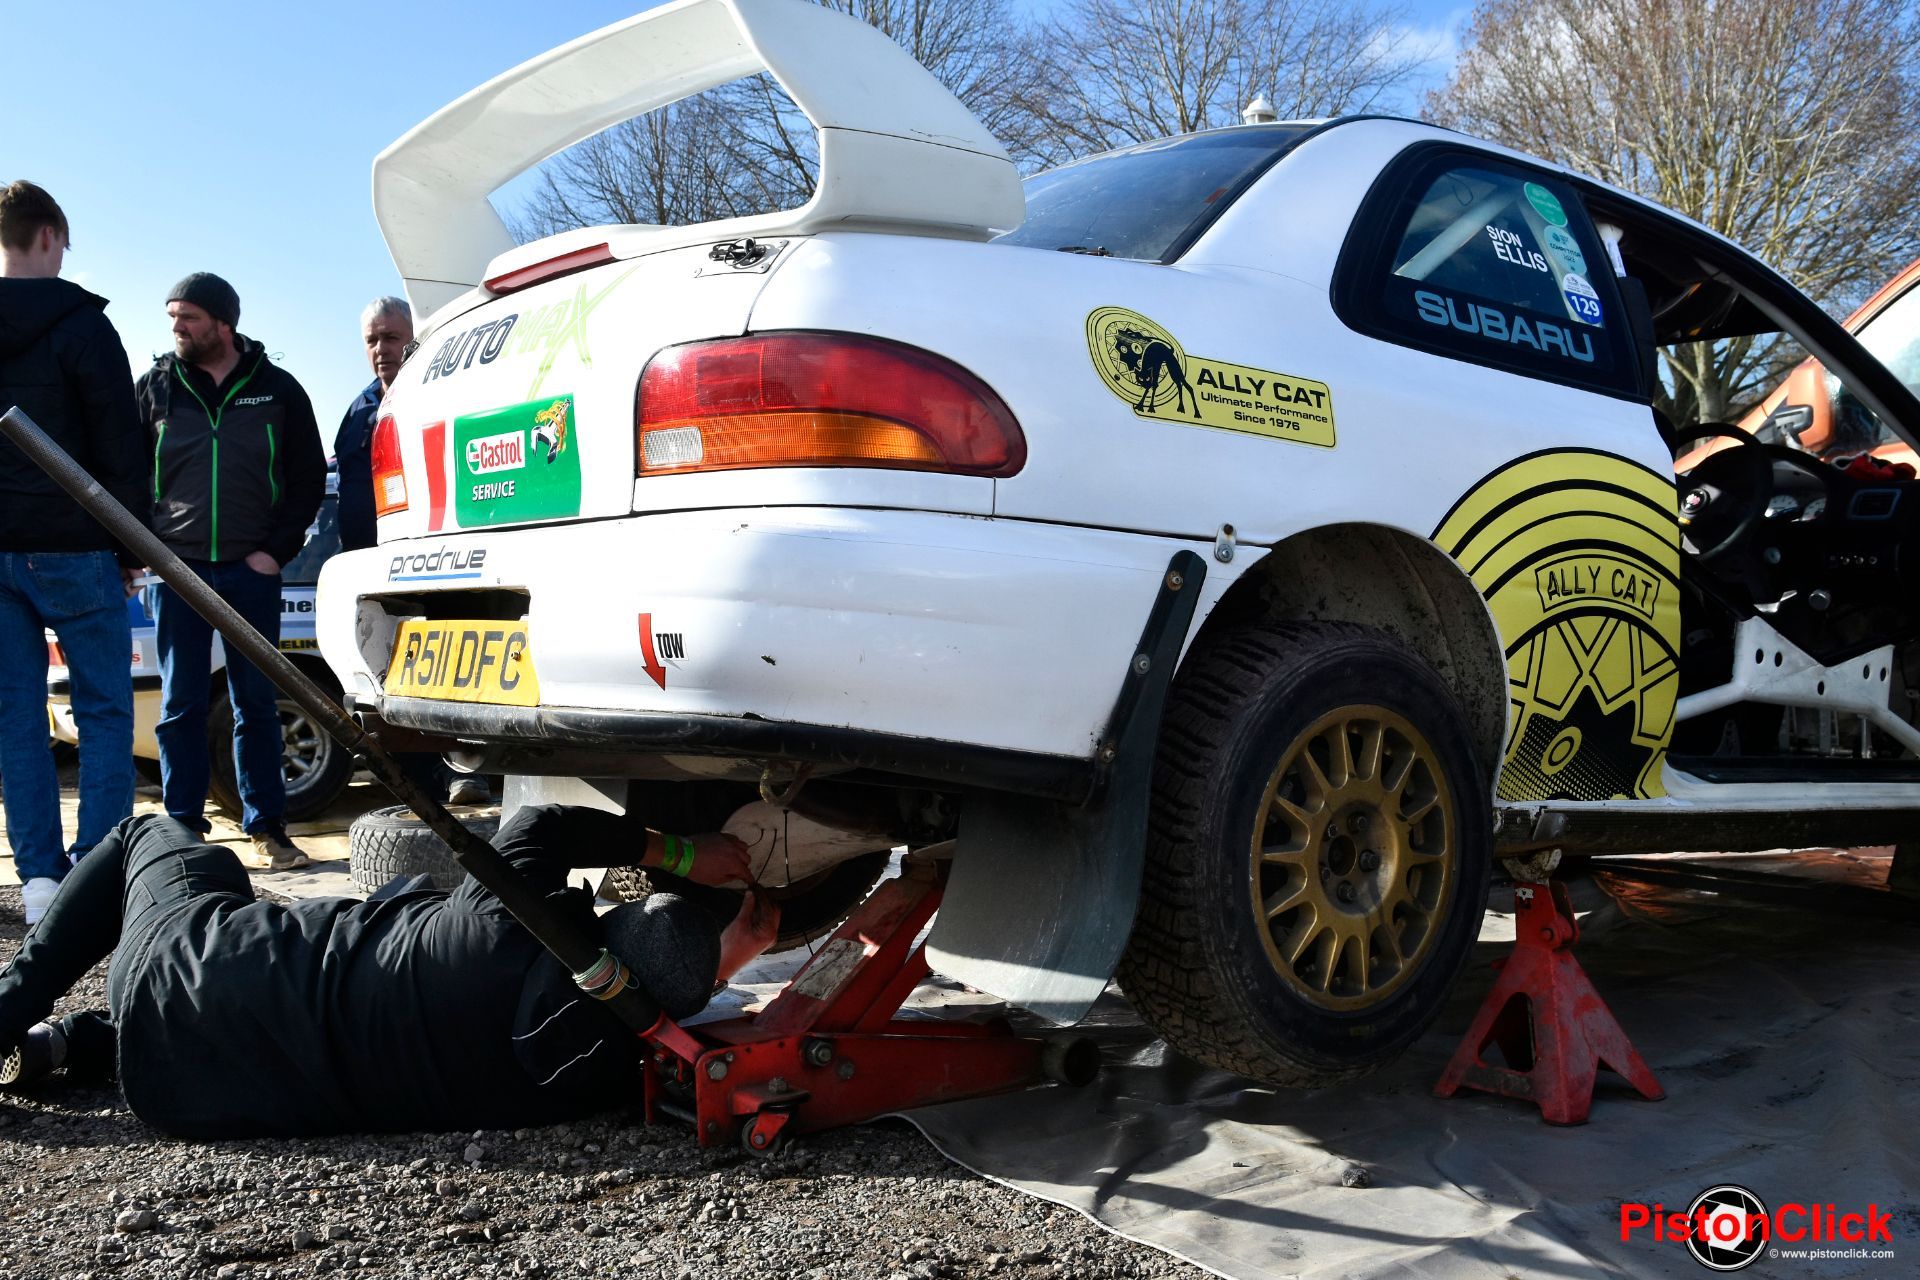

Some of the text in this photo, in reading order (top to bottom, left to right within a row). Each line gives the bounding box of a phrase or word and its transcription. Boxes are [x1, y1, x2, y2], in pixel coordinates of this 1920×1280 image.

[1486, 225, 1523, 248] SION
[1492, 241, 1549, 273] ELLIS
[1571, 295, 1601, 318] 129
[422, 268, 630, 398] AUTOMAX
[1414, 290, 1595, 363] SUBARU
[1196, 368, 1326, 409] ALLY CAT
[1200, 391, 1328, 424] Ultimate Performance
[1234, 410, 1301, 431] Since 1976
[480, 436, 523, 469] Castrol
[472, 480, 515, 501] SERVICE
[388, 545, 487, 583] prodrive
[1546, 565, 1653, 609] ALLY CAT
[399, 630, 527, 692] R511 DFC
[655, 633, 685, 659] TOW
